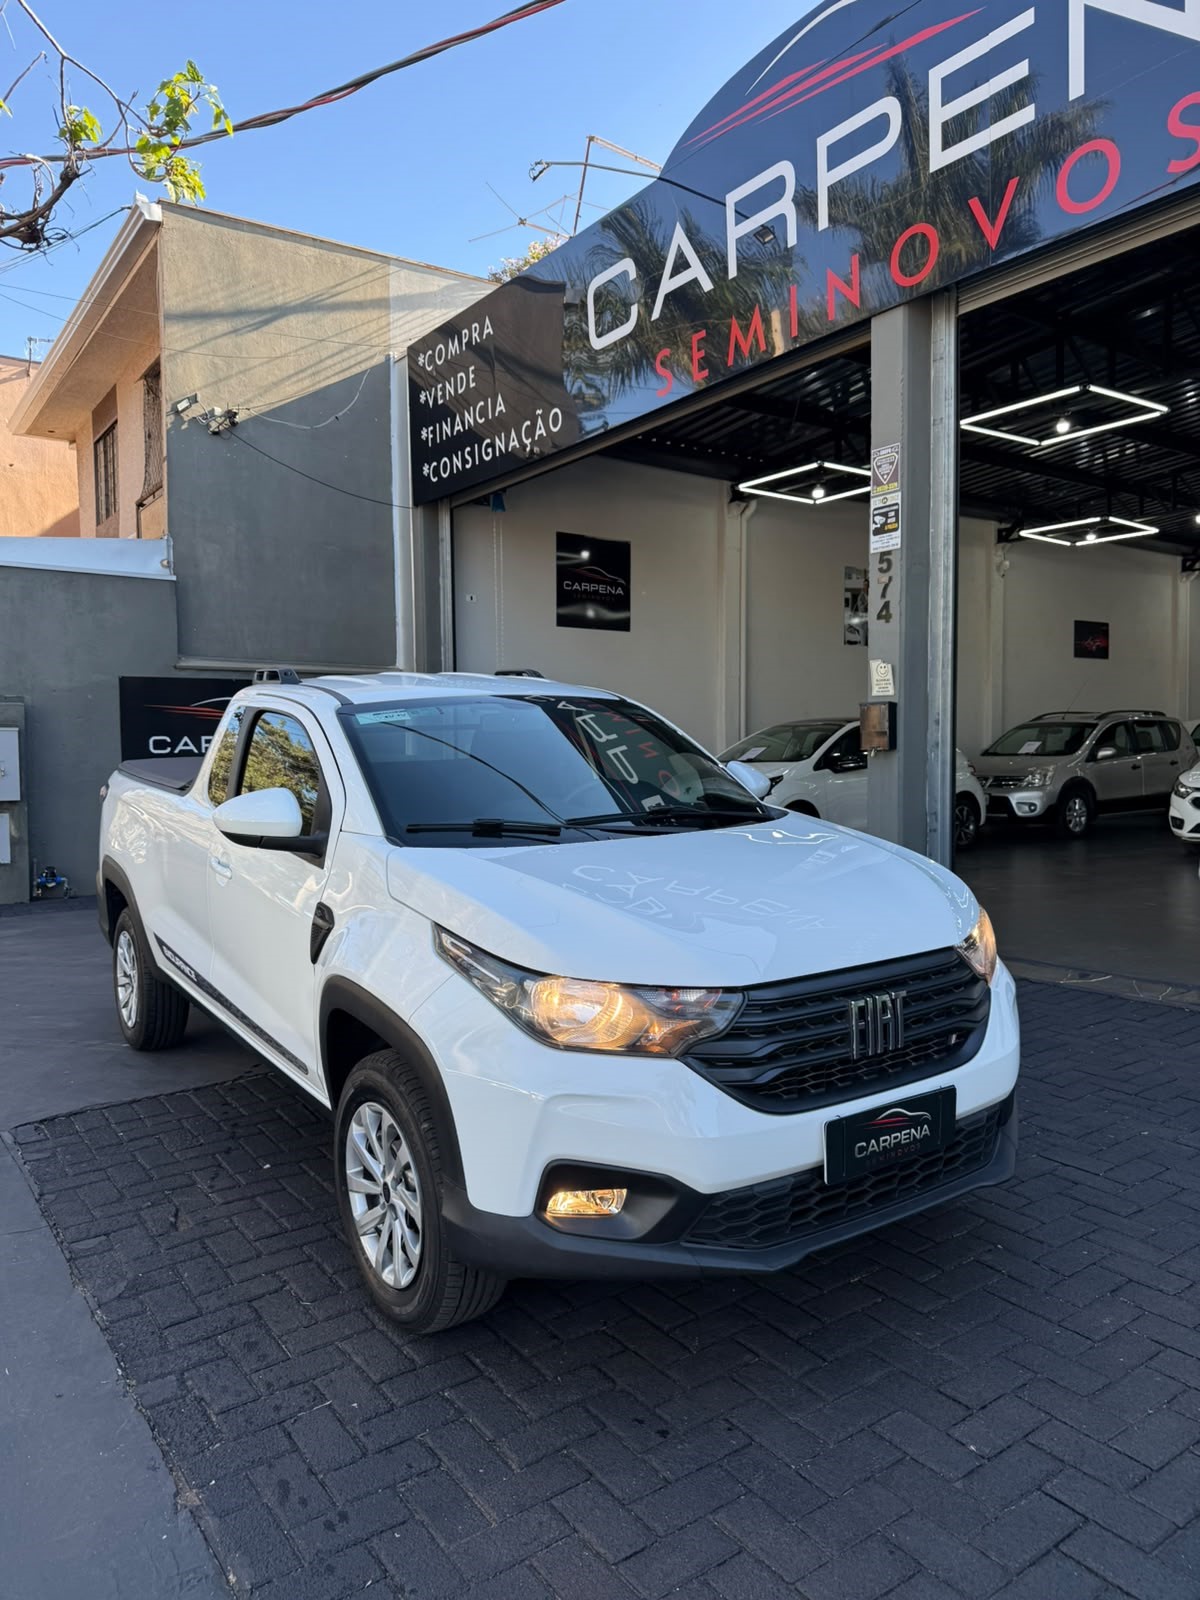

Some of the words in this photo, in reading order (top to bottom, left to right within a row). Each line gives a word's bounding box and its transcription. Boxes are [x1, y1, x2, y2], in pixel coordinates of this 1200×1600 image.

[563, 580, 624, 596] CARPENA
[851, 990, 907, 1060] FIAT
[854, 1124, 931, 1158] CARPENA
